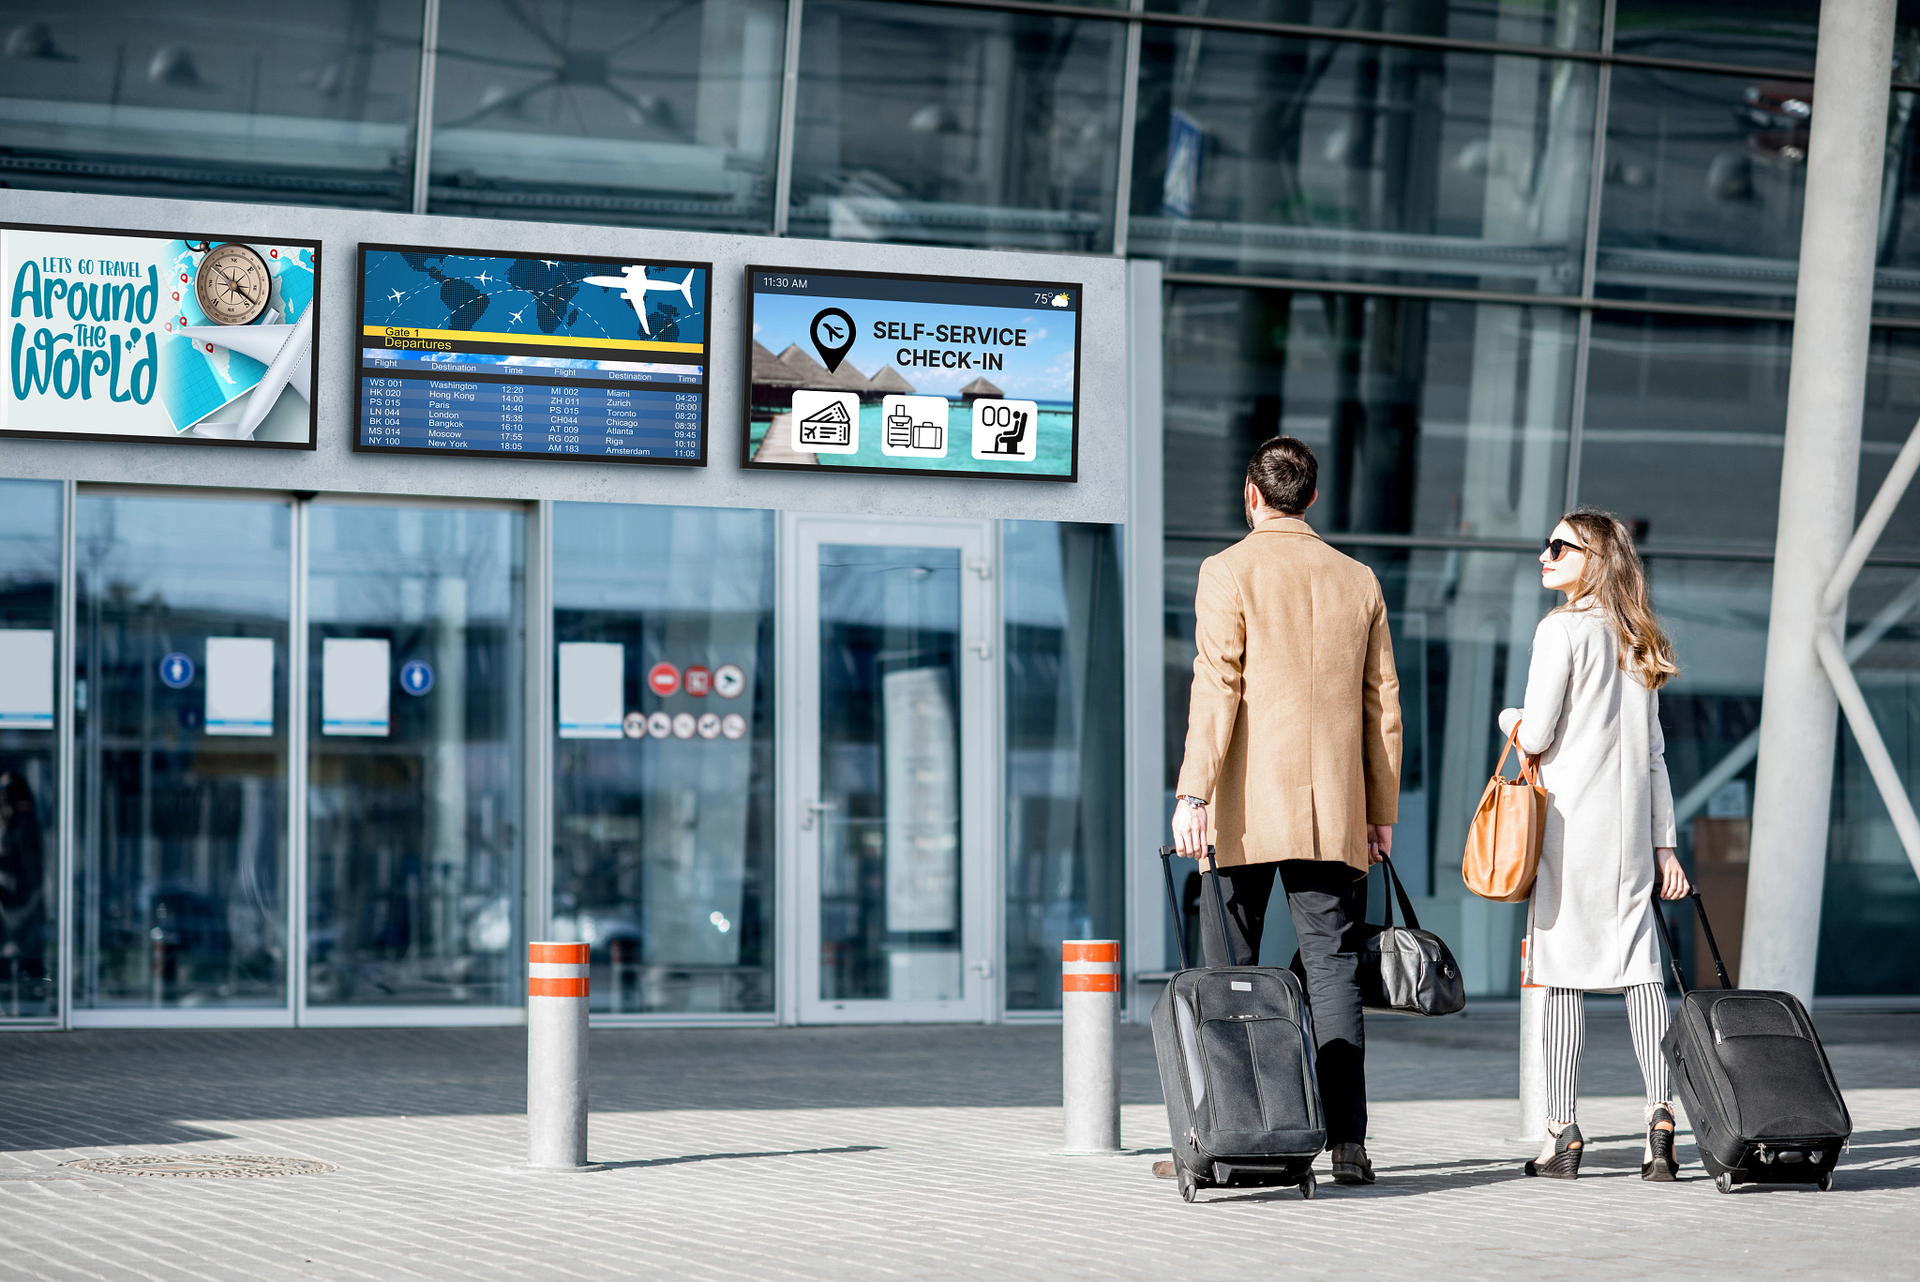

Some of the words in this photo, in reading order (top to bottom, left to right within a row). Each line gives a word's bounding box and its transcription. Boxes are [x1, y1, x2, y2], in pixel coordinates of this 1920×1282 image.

[42, 257, 72, 274] LET'S
[78, 259, 94, 275] GO
[98, 261, 142, 278] TRAVEL
[764, 277, 789, 288] 11:30
[792, 278, 808, 289] AM
[11, 260, 159, 324] Around
[385, 327, 410, 337] Gate
[415, 329, 419, 337] 1
[873, 321, 1027, 347] SELF-SERVICE
[385, 337, 452, 350] Departures
[374, 359, 398, 368] Flight
[896, 348, 1003, 371] CHECK-IN
[431, 363, 476, 372] Destination
[554, 368, 576, 377] Flight
[608, 372, 652, 381] Destination
[370, 379, 385, 387] WS
[678, 375, 697, 383] Time
[430, 381, 477, 391] Washington
[502, 386, 523, 394] 12:20
[429, 391, 451, 400] Hong
[454, 392, 475, 401] Kong
[564, 388, 579, 396] 002
[607, 390, 630, 398] Miami
[502, 395, 523, 403] 14:00
[676, 394, 697, 402] 04:20
[385, 399, 400, 407] 015
[429, 401, 450, 409] Paris
[675, 403, 697, 411] 05:00
[429, 411, 459, 419] London
[501, 414, 523, 422] 15:35
[675, 412, 697, 420] 08:20
[384, 418, 400, 426] 004
[429, 420, 464, 429] Bangkok
[606, 419, 638, 428] Chicago
[675, 422, 696, 430] 08:35
[428, 430, 462, 438] Moscow
[501, 433, 523, 441] 17:55
[606, 437, 624, 446] Riga
[675, 440, 696, 448] 10:10
[606, 447, 650, 455] Amsterdam
